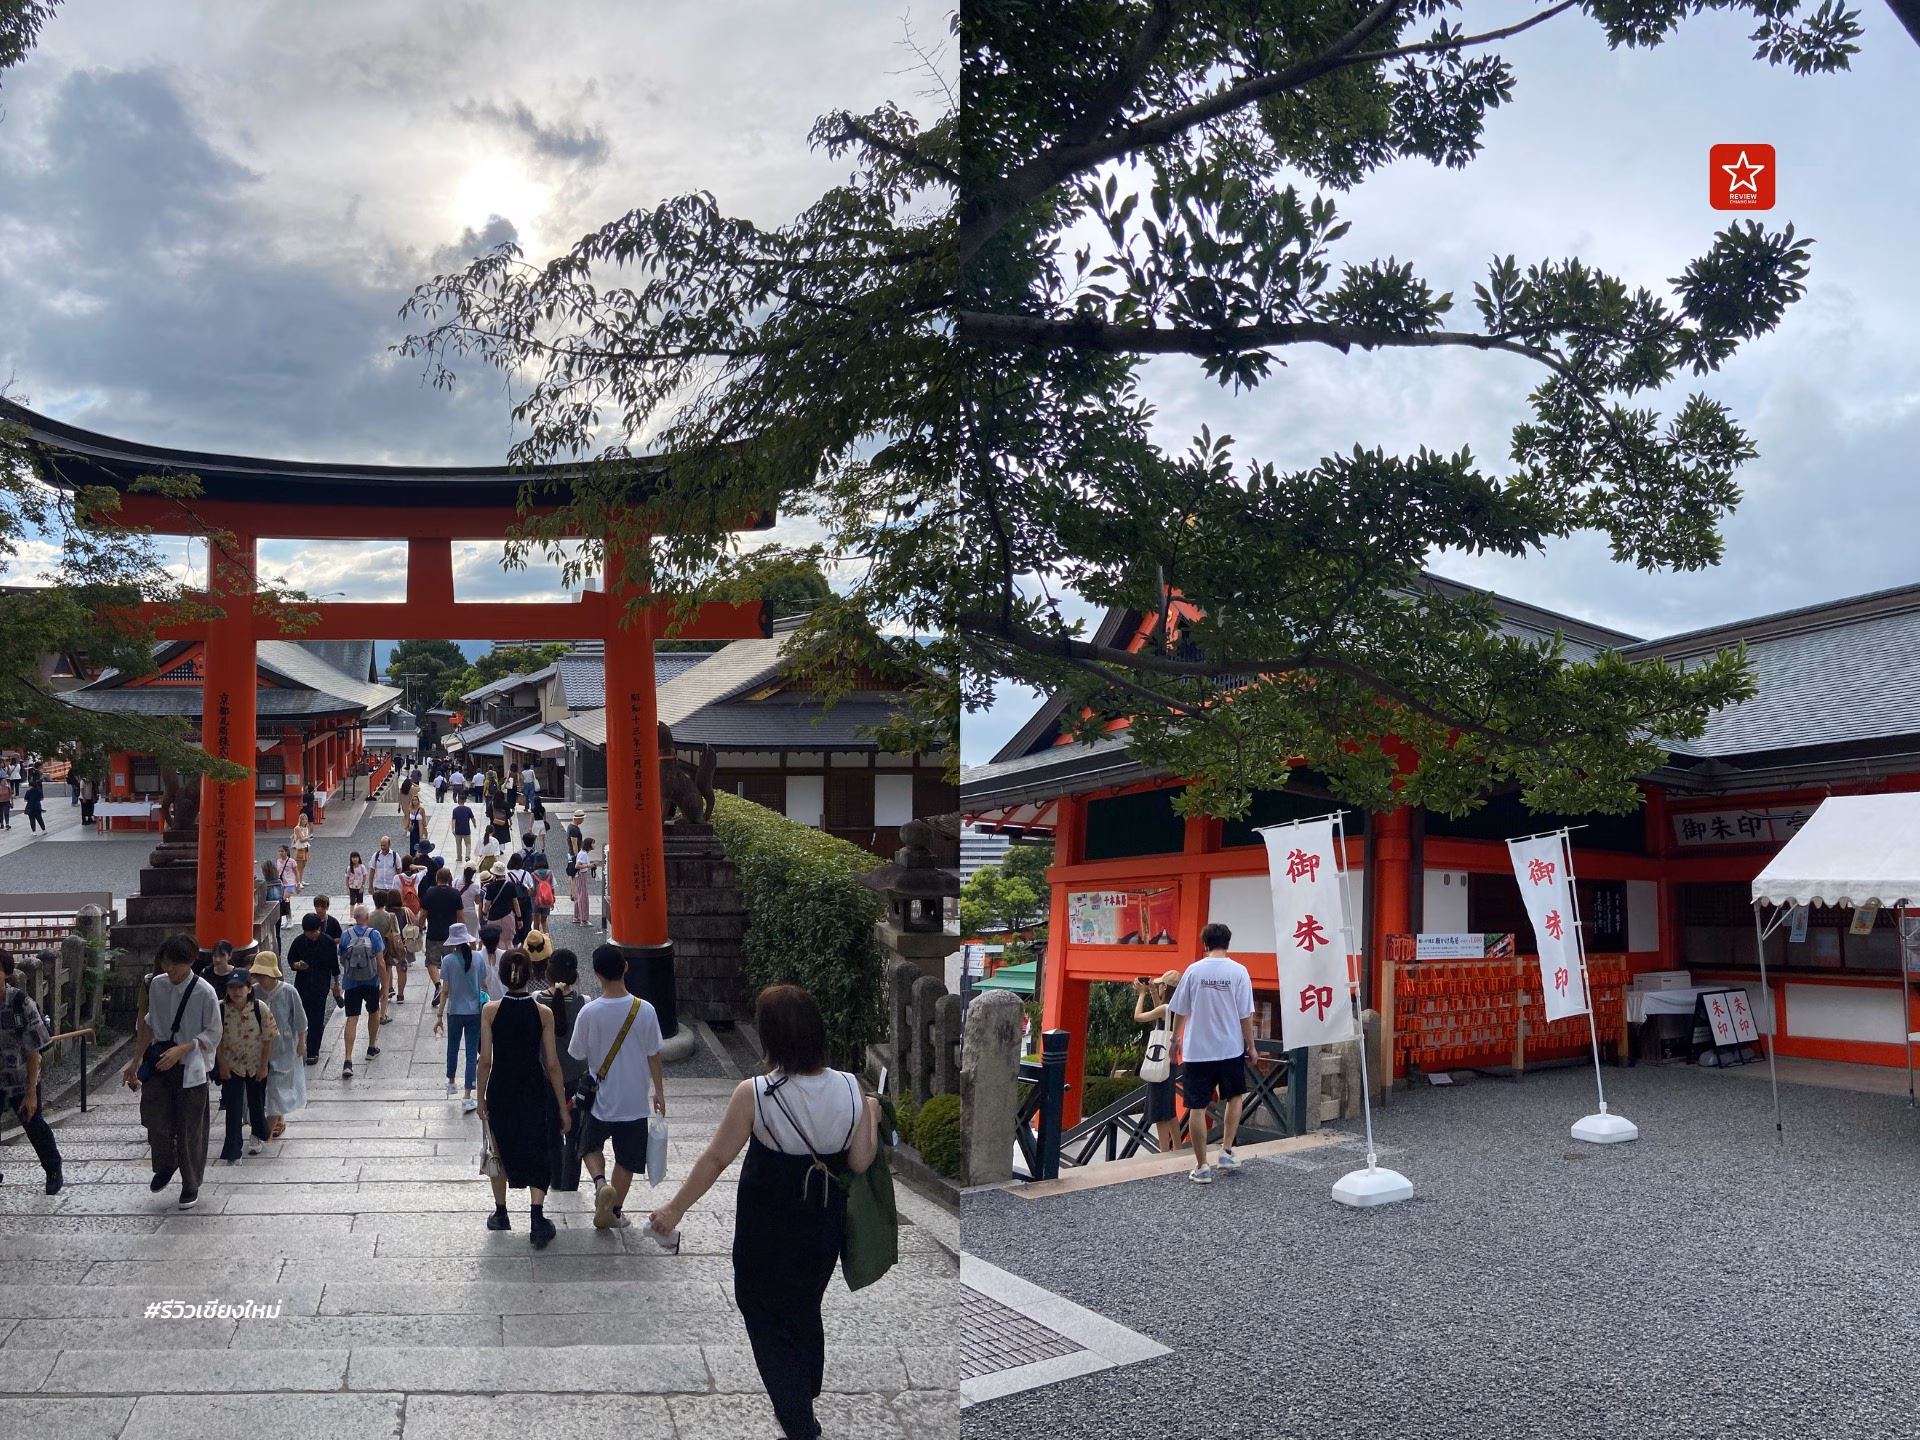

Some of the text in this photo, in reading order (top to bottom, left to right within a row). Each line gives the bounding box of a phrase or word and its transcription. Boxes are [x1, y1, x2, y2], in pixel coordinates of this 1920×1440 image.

[1682, 815, 1762, 841] 御朱印
[1103, 894, 1127, 907] 千本鳥居
[1286, 848, 1334, 1022] 御朱印
[1528, 858, 1569, 998] 御朱印
[1712, 998, 1728, 1039] 朱印
[1734, 996, 1750, 1036] 朱印
